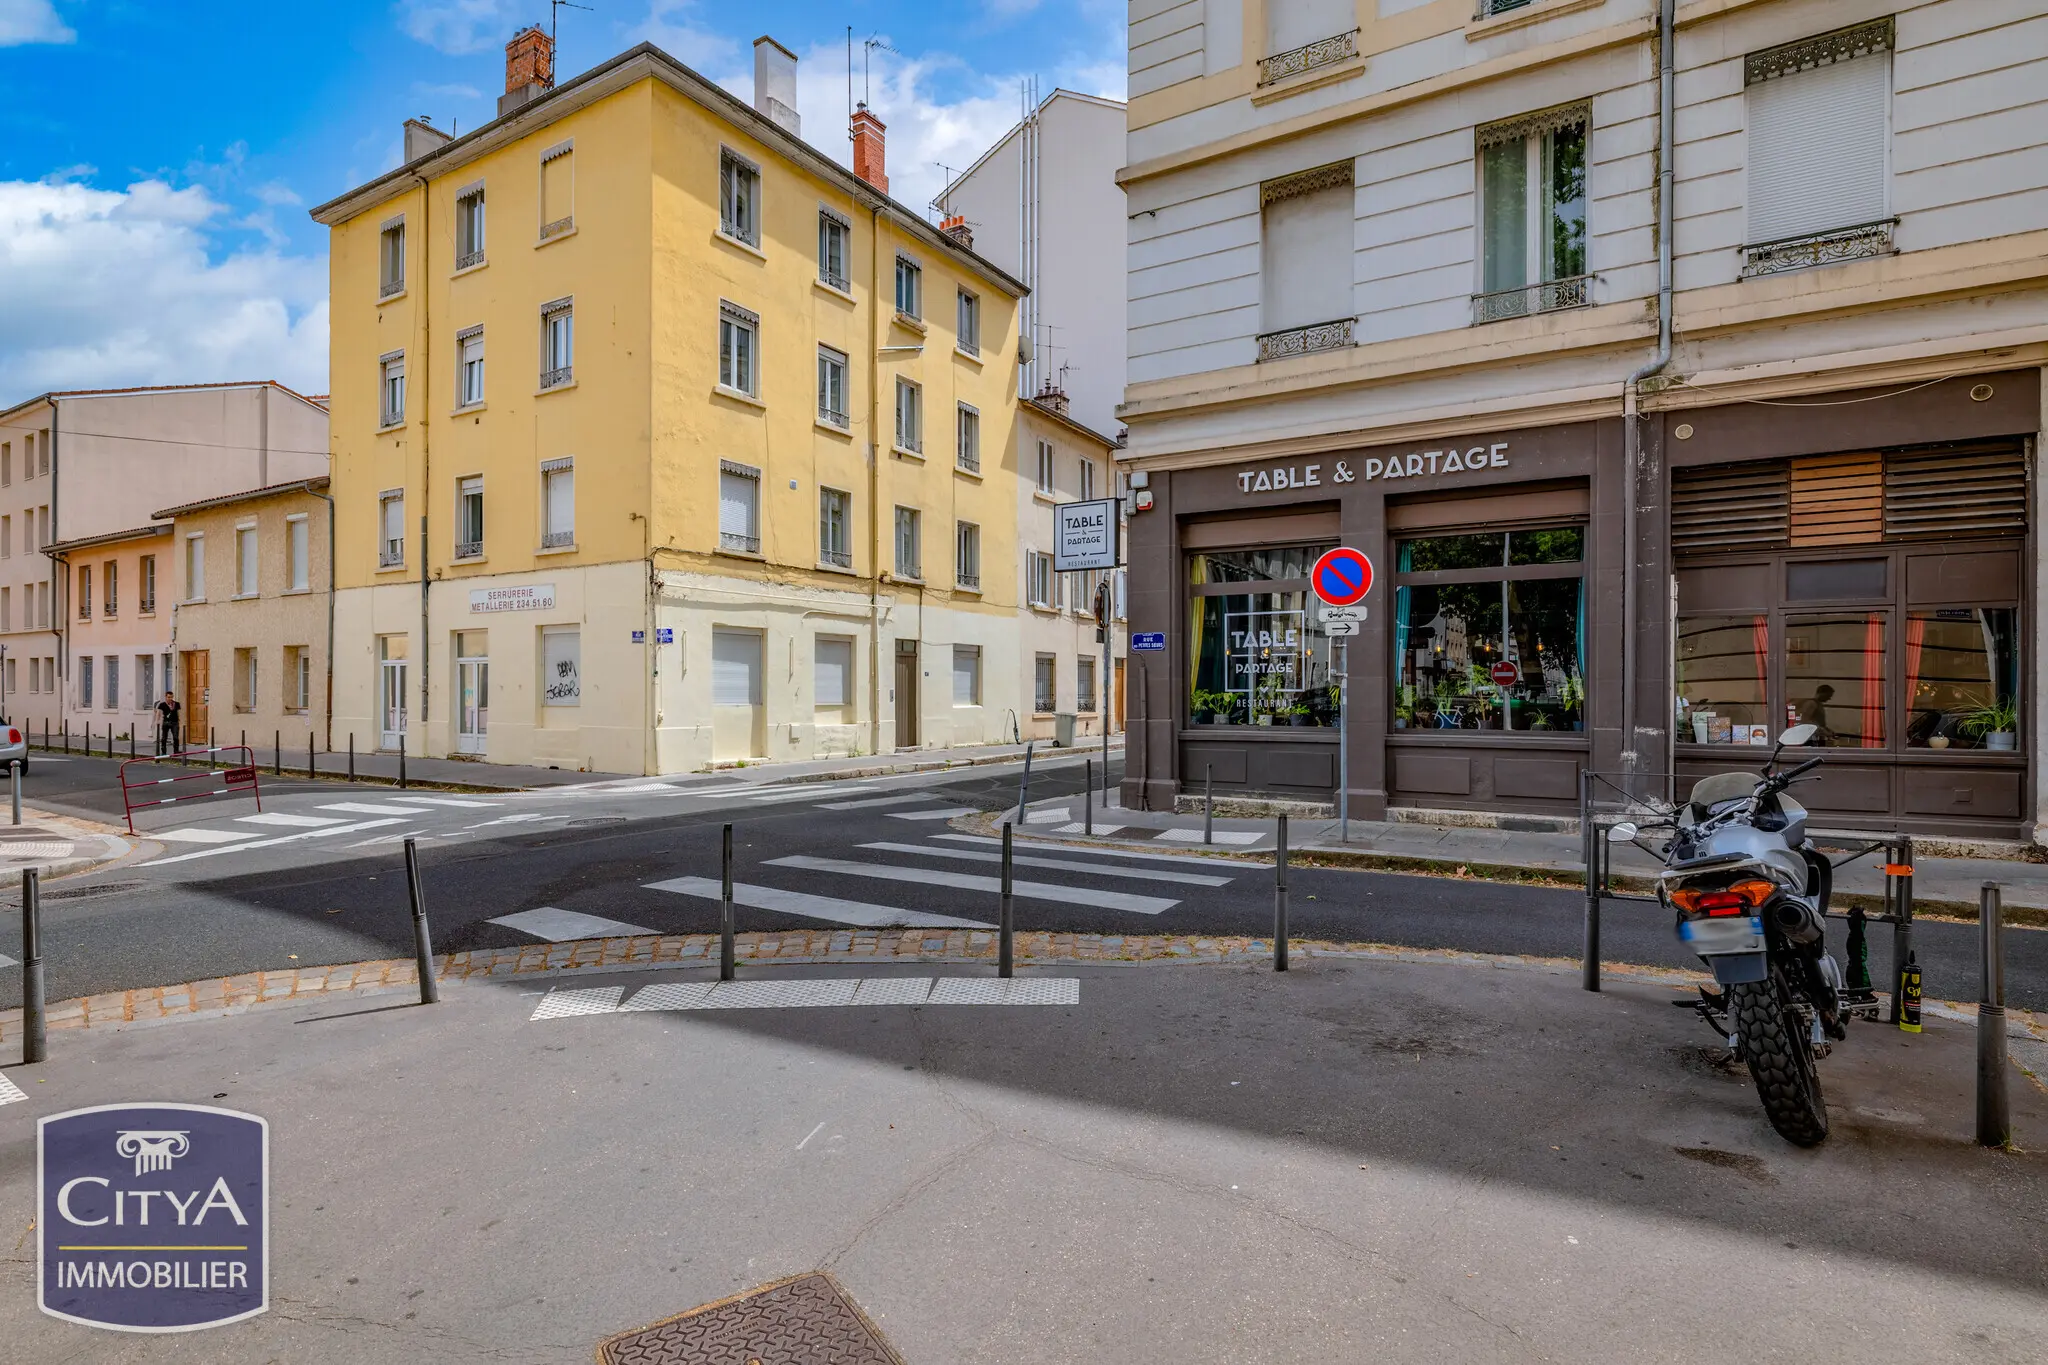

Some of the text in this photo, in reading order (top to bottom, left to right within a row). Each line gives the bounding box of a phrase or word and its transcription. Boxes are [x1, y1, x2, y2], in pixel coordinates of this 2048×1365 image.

[1238, 443, 1509, 493] TABLE & PARTAGE
[1065, 515, 1104, 529] TABLE
[1067, 536, 1101, 545] PARTAGE
[1068, 559, 1100, 567] RESTAURANT
[488, 588, 534, 600] SERRURERIE
[472, 597, 553, 612] METALLERIE 234.51.60
[1231, 629, 1298, 648] TABLE
[1235, 662, 1293, 674] PARTAGE
[1236, 698, 1293, 709] RESTAURANT
